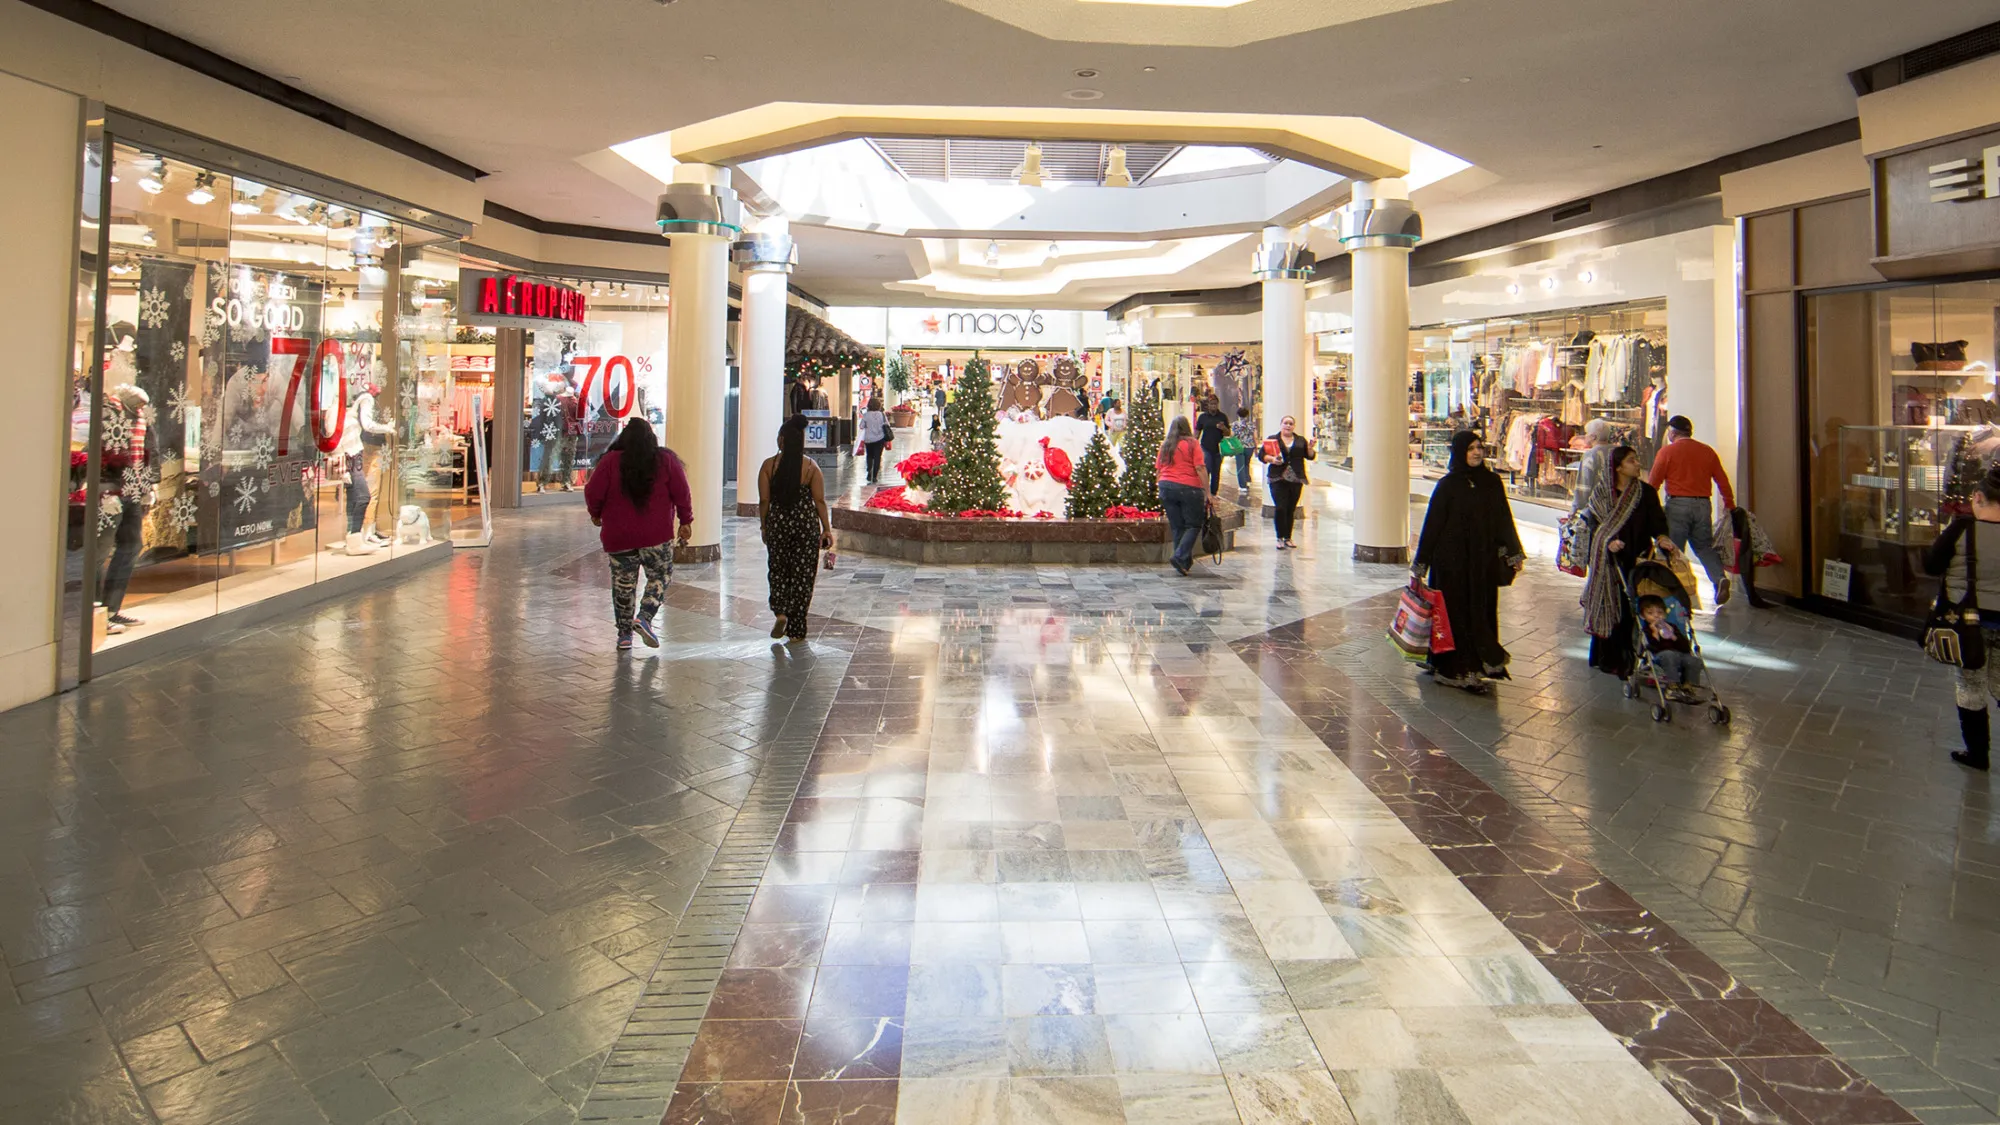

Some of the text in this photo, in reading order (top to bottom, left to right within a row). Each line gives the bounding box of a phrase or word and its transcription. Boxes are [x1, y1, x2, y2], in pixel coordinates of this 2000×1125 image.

[212, 297, 304, 332] SO GOOD
[809, 426, 822, 440] 50
[234, 523, 256, 537] AERO
